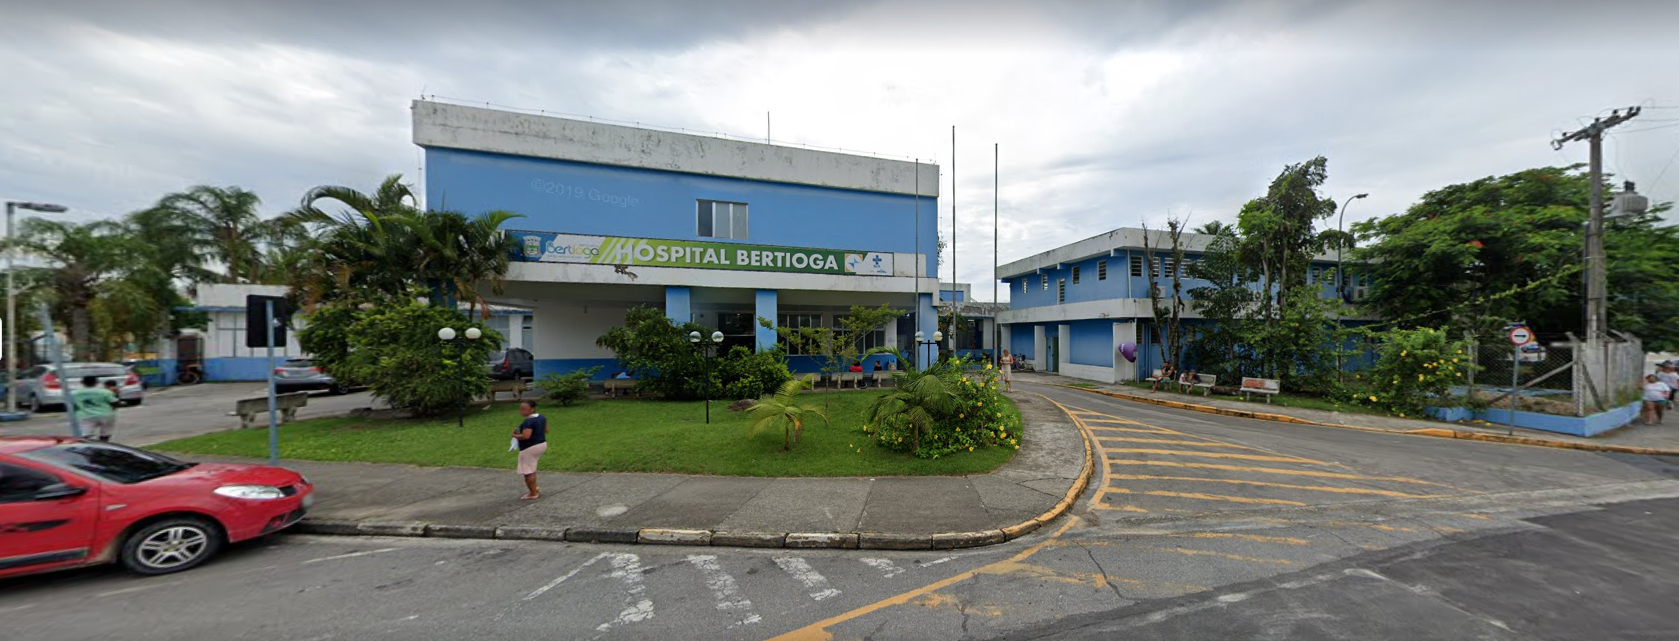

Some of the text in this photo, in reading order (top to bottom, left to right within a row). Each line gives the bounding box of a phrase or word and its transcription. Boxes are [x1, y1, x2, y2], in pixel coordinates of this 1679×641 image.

[546, 240, 600, 259] Bertioga
[616, 241, 839, 270] HOSPITAL BERTIOGA
